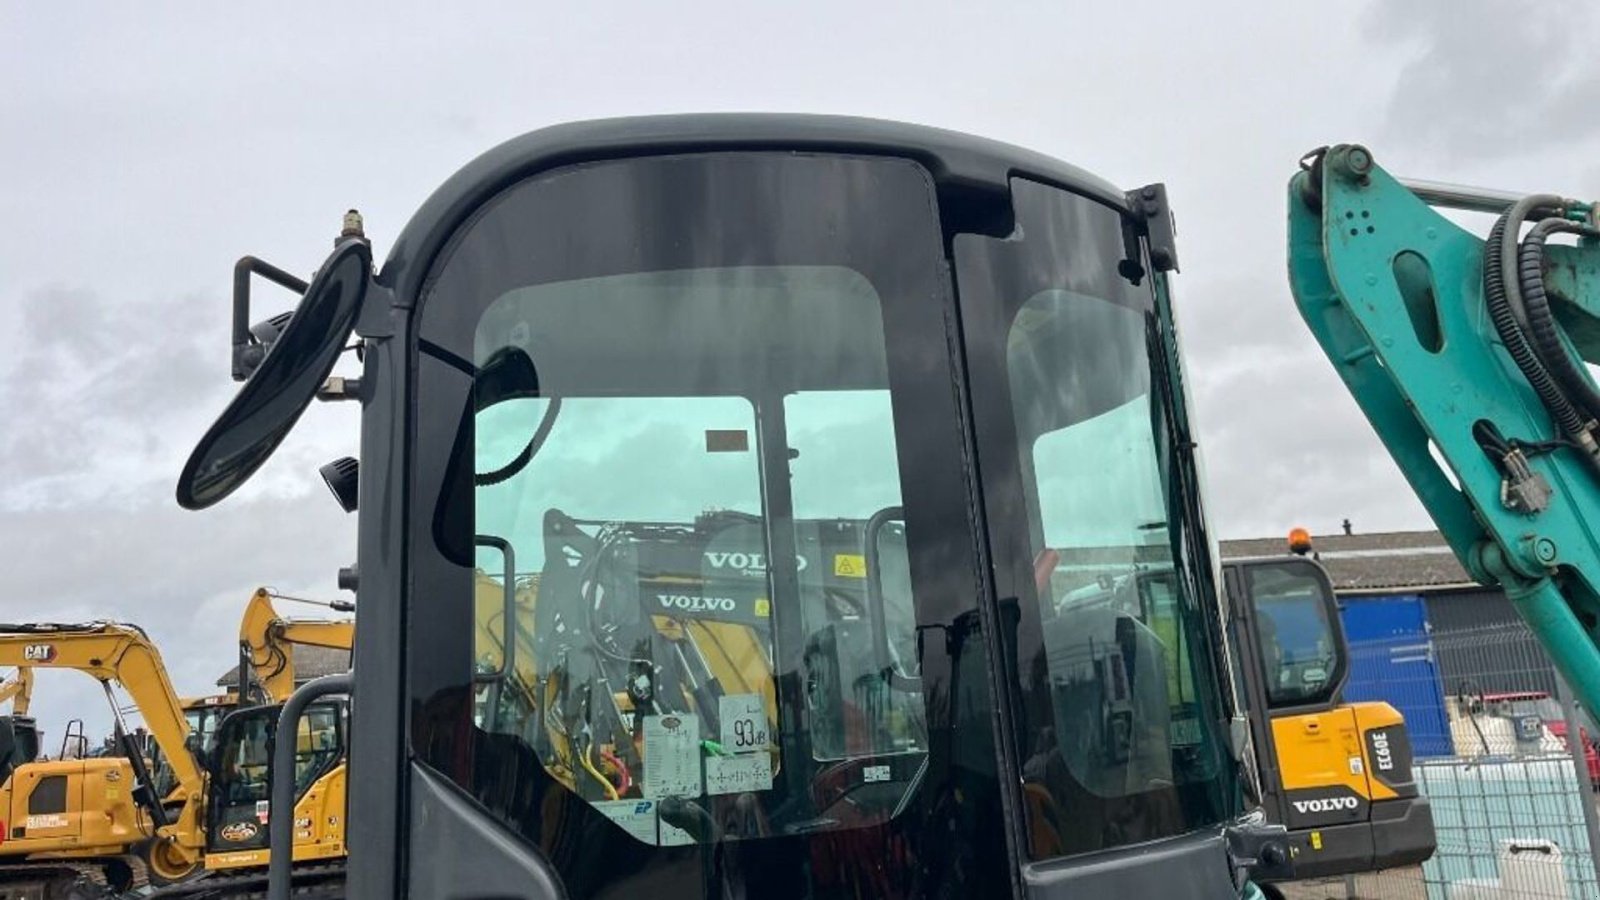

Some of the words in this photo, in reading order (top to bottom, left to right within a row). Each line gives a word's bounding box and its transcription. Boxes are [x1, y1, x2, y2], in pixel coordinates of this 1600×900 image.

[703, 552, 808, 572] VOLO
[657, 594, 736, 611] VOLVO
[24, 644, 51, 660] CAT
[734, 719, 755, 747] 93
[1372, 732, 1393, 770] EC60E
[1293, 796, 1359, 814] VOLVO
